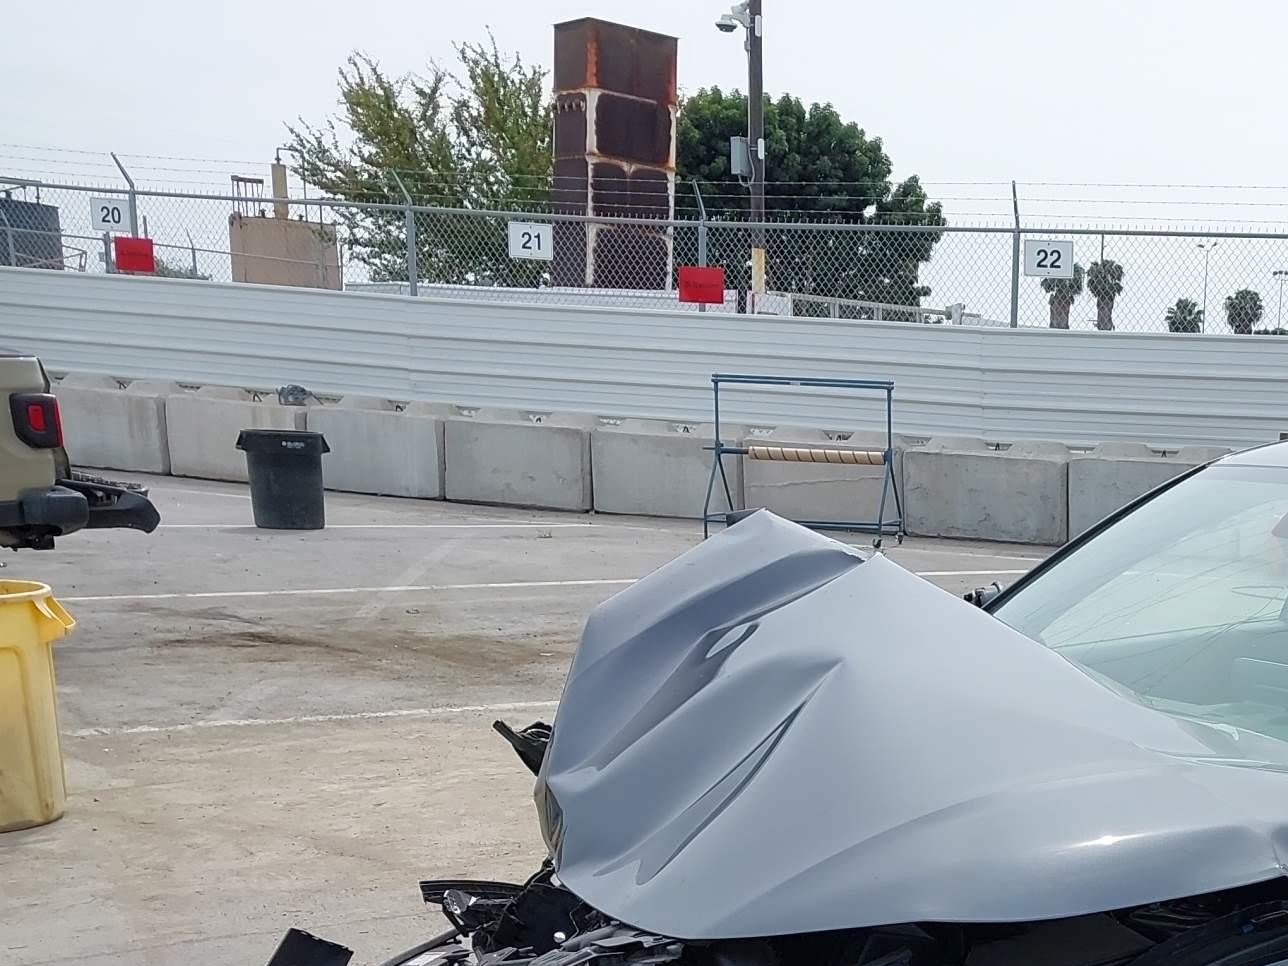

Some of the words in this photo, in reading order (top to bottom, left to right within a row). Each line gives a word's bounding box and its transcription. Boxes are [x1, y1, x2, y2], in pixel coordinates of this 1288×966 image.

[100, 206, 122, 224] 20
[520, 231, 542, 251] 21
[1036, 248, 1062, 269] 22
